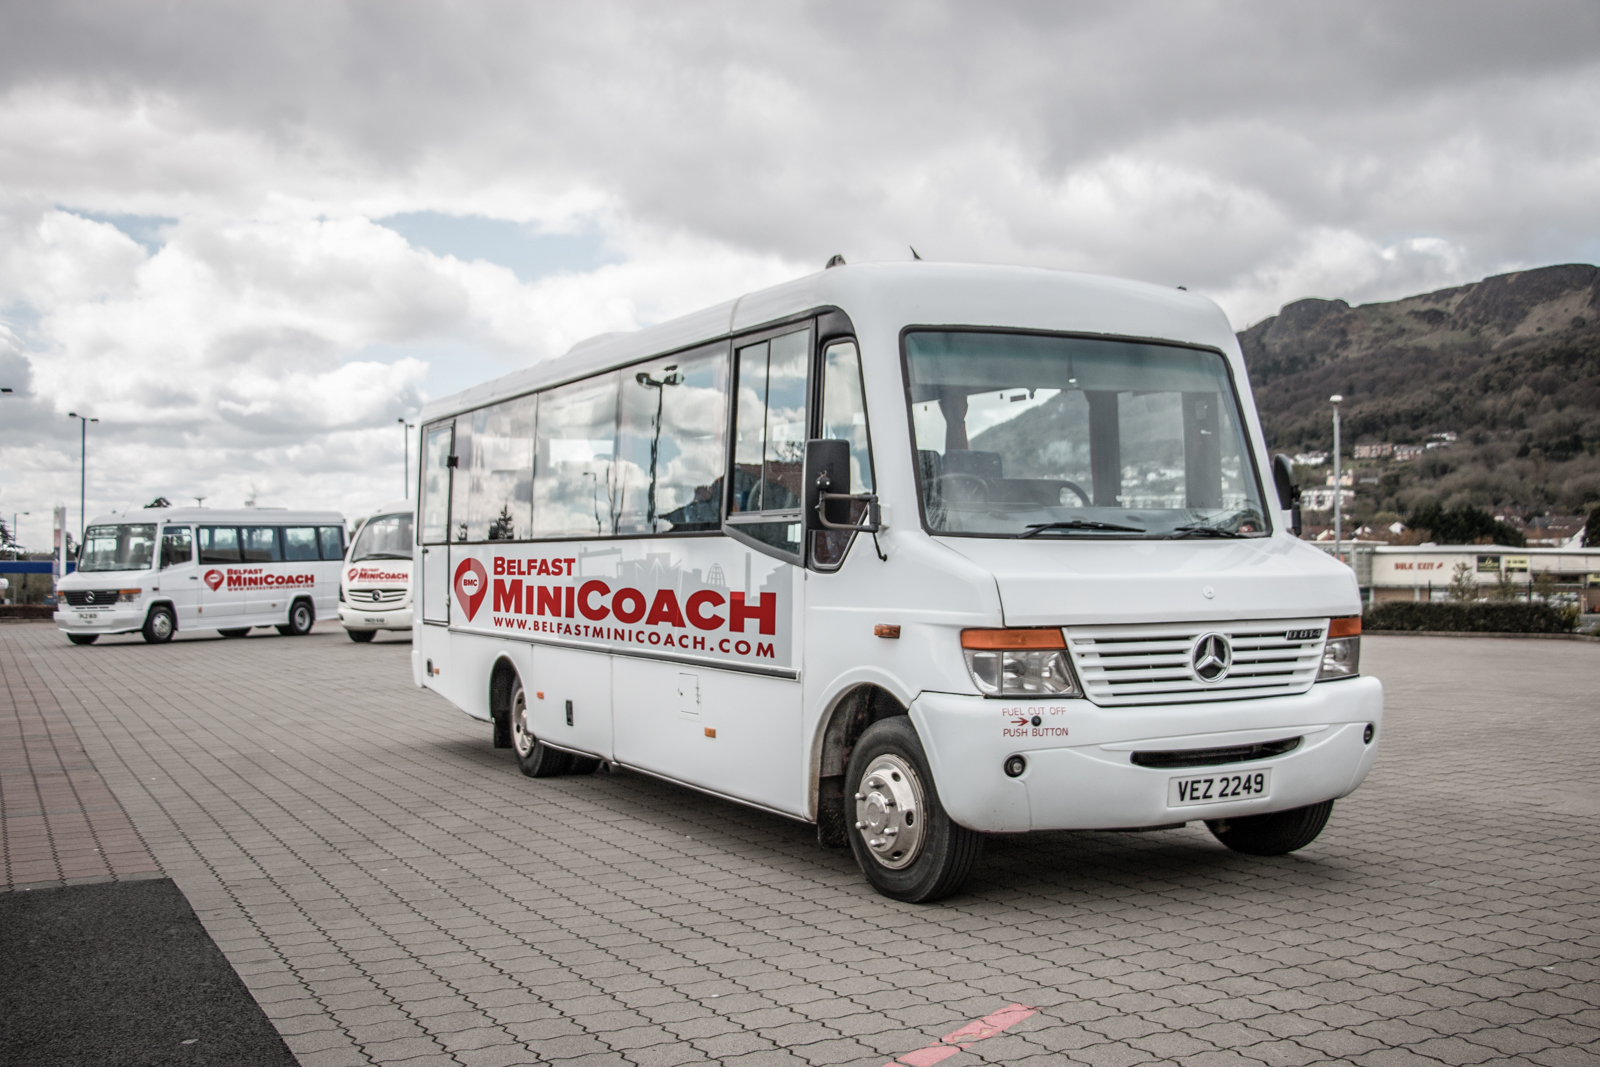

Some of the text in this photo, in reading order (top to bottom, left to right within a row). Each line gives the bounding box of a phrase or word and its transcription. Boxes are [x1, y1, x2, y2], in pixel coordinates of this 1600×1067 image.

[493, 556, 576, 576] BELFAST
[1417, 562, 1435, 570] EXIT
[226, 574, 315, 587] MINICOACH
[358, 571, 408, 580] MINICOACH
[463, 578, 478, 586] BMC
[493, 579, 777, 636] MINICOACH
[493, 616, 776, 659] WWW.BELFASTMINICOACH.COM
[1299, 629, 1321, 638] 814
[1002, 706, 1067, 717] FUEL CUT OFF
[1003, 727, 1069, 738] PUSH BUTTON
[1178, 773, 1264, 802] VEZ 2249
